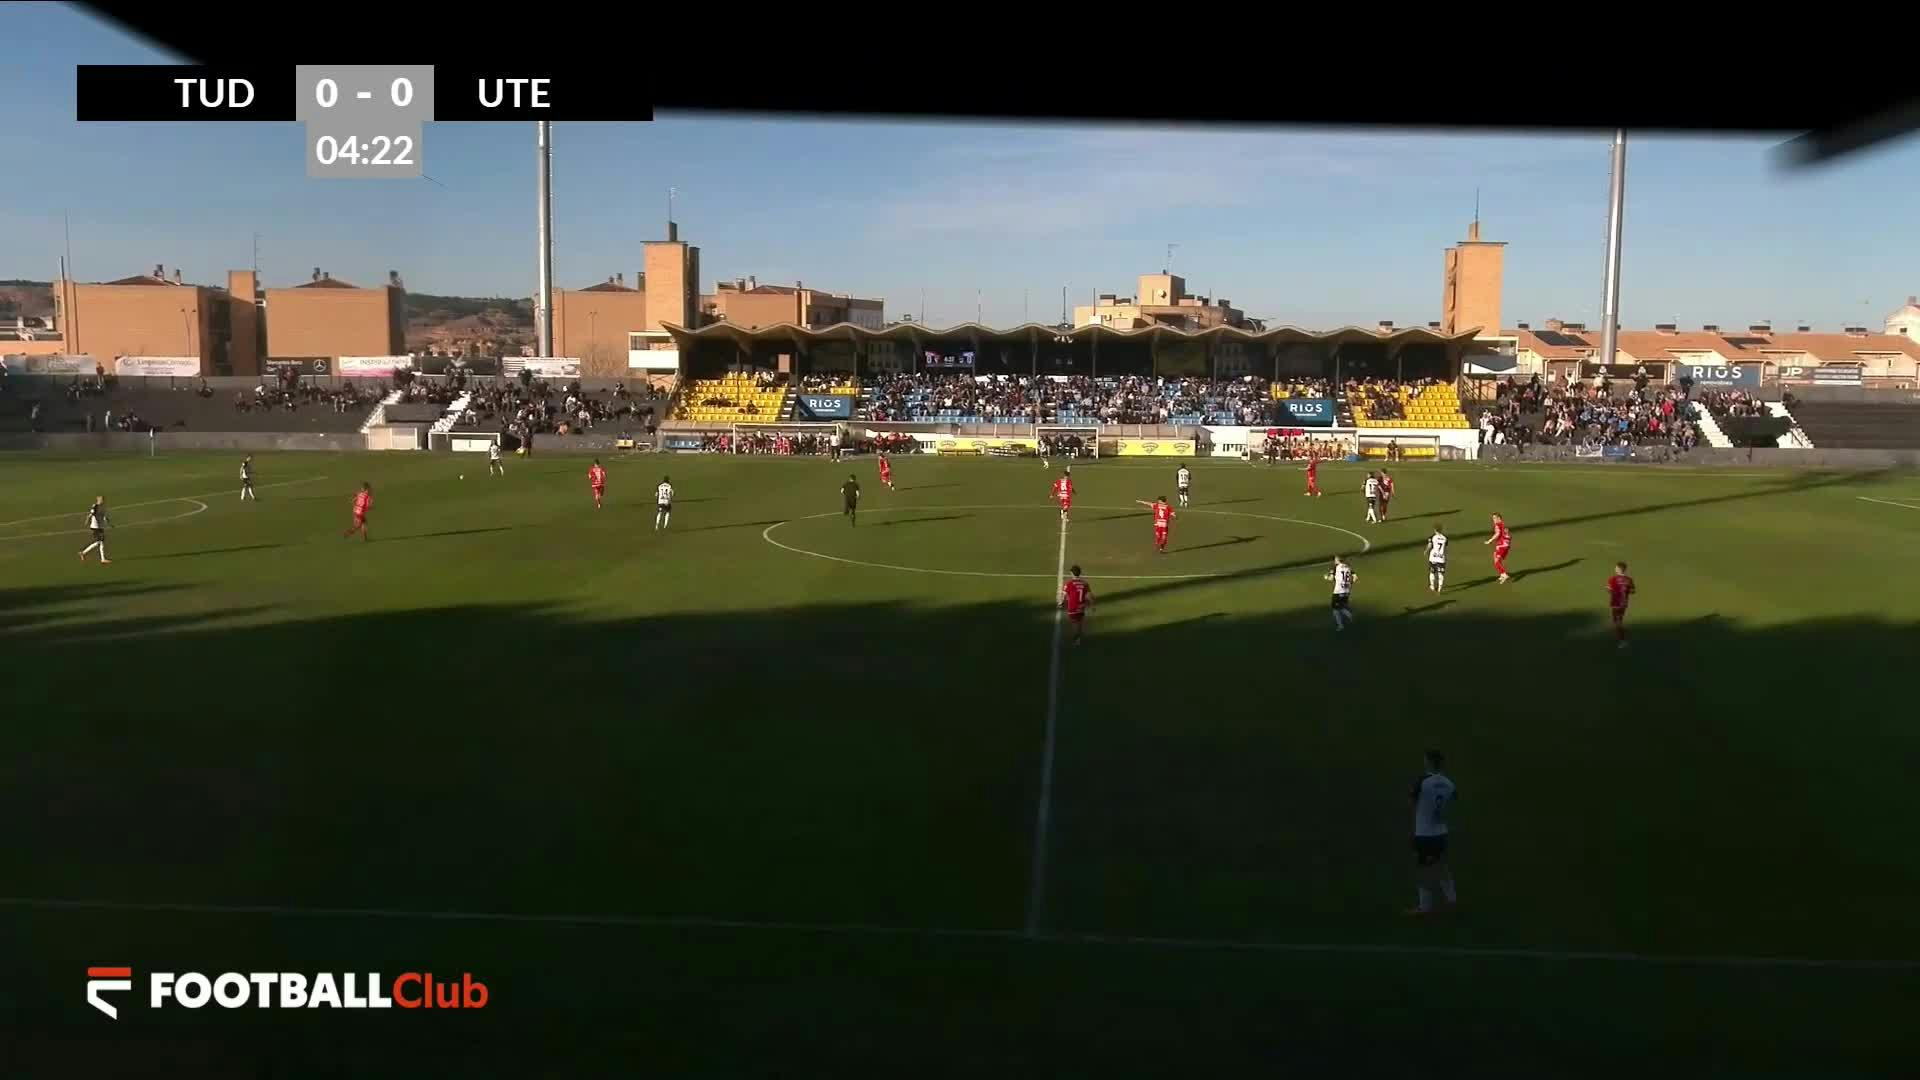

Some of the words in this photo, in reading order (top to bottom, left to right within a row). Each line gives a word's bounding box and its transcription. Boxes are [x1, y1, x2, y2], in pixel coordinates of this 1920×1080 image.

[1692, 365, 1742, 379] RIOS
[1780, 366, 1804, 378] JP
[809, 399, 841, 408] RIOS
[1289, 403, 1323, 413] RIOS
[1437, 542, 1443, 551] 7
[1077, 589, 1083, 603] 7
